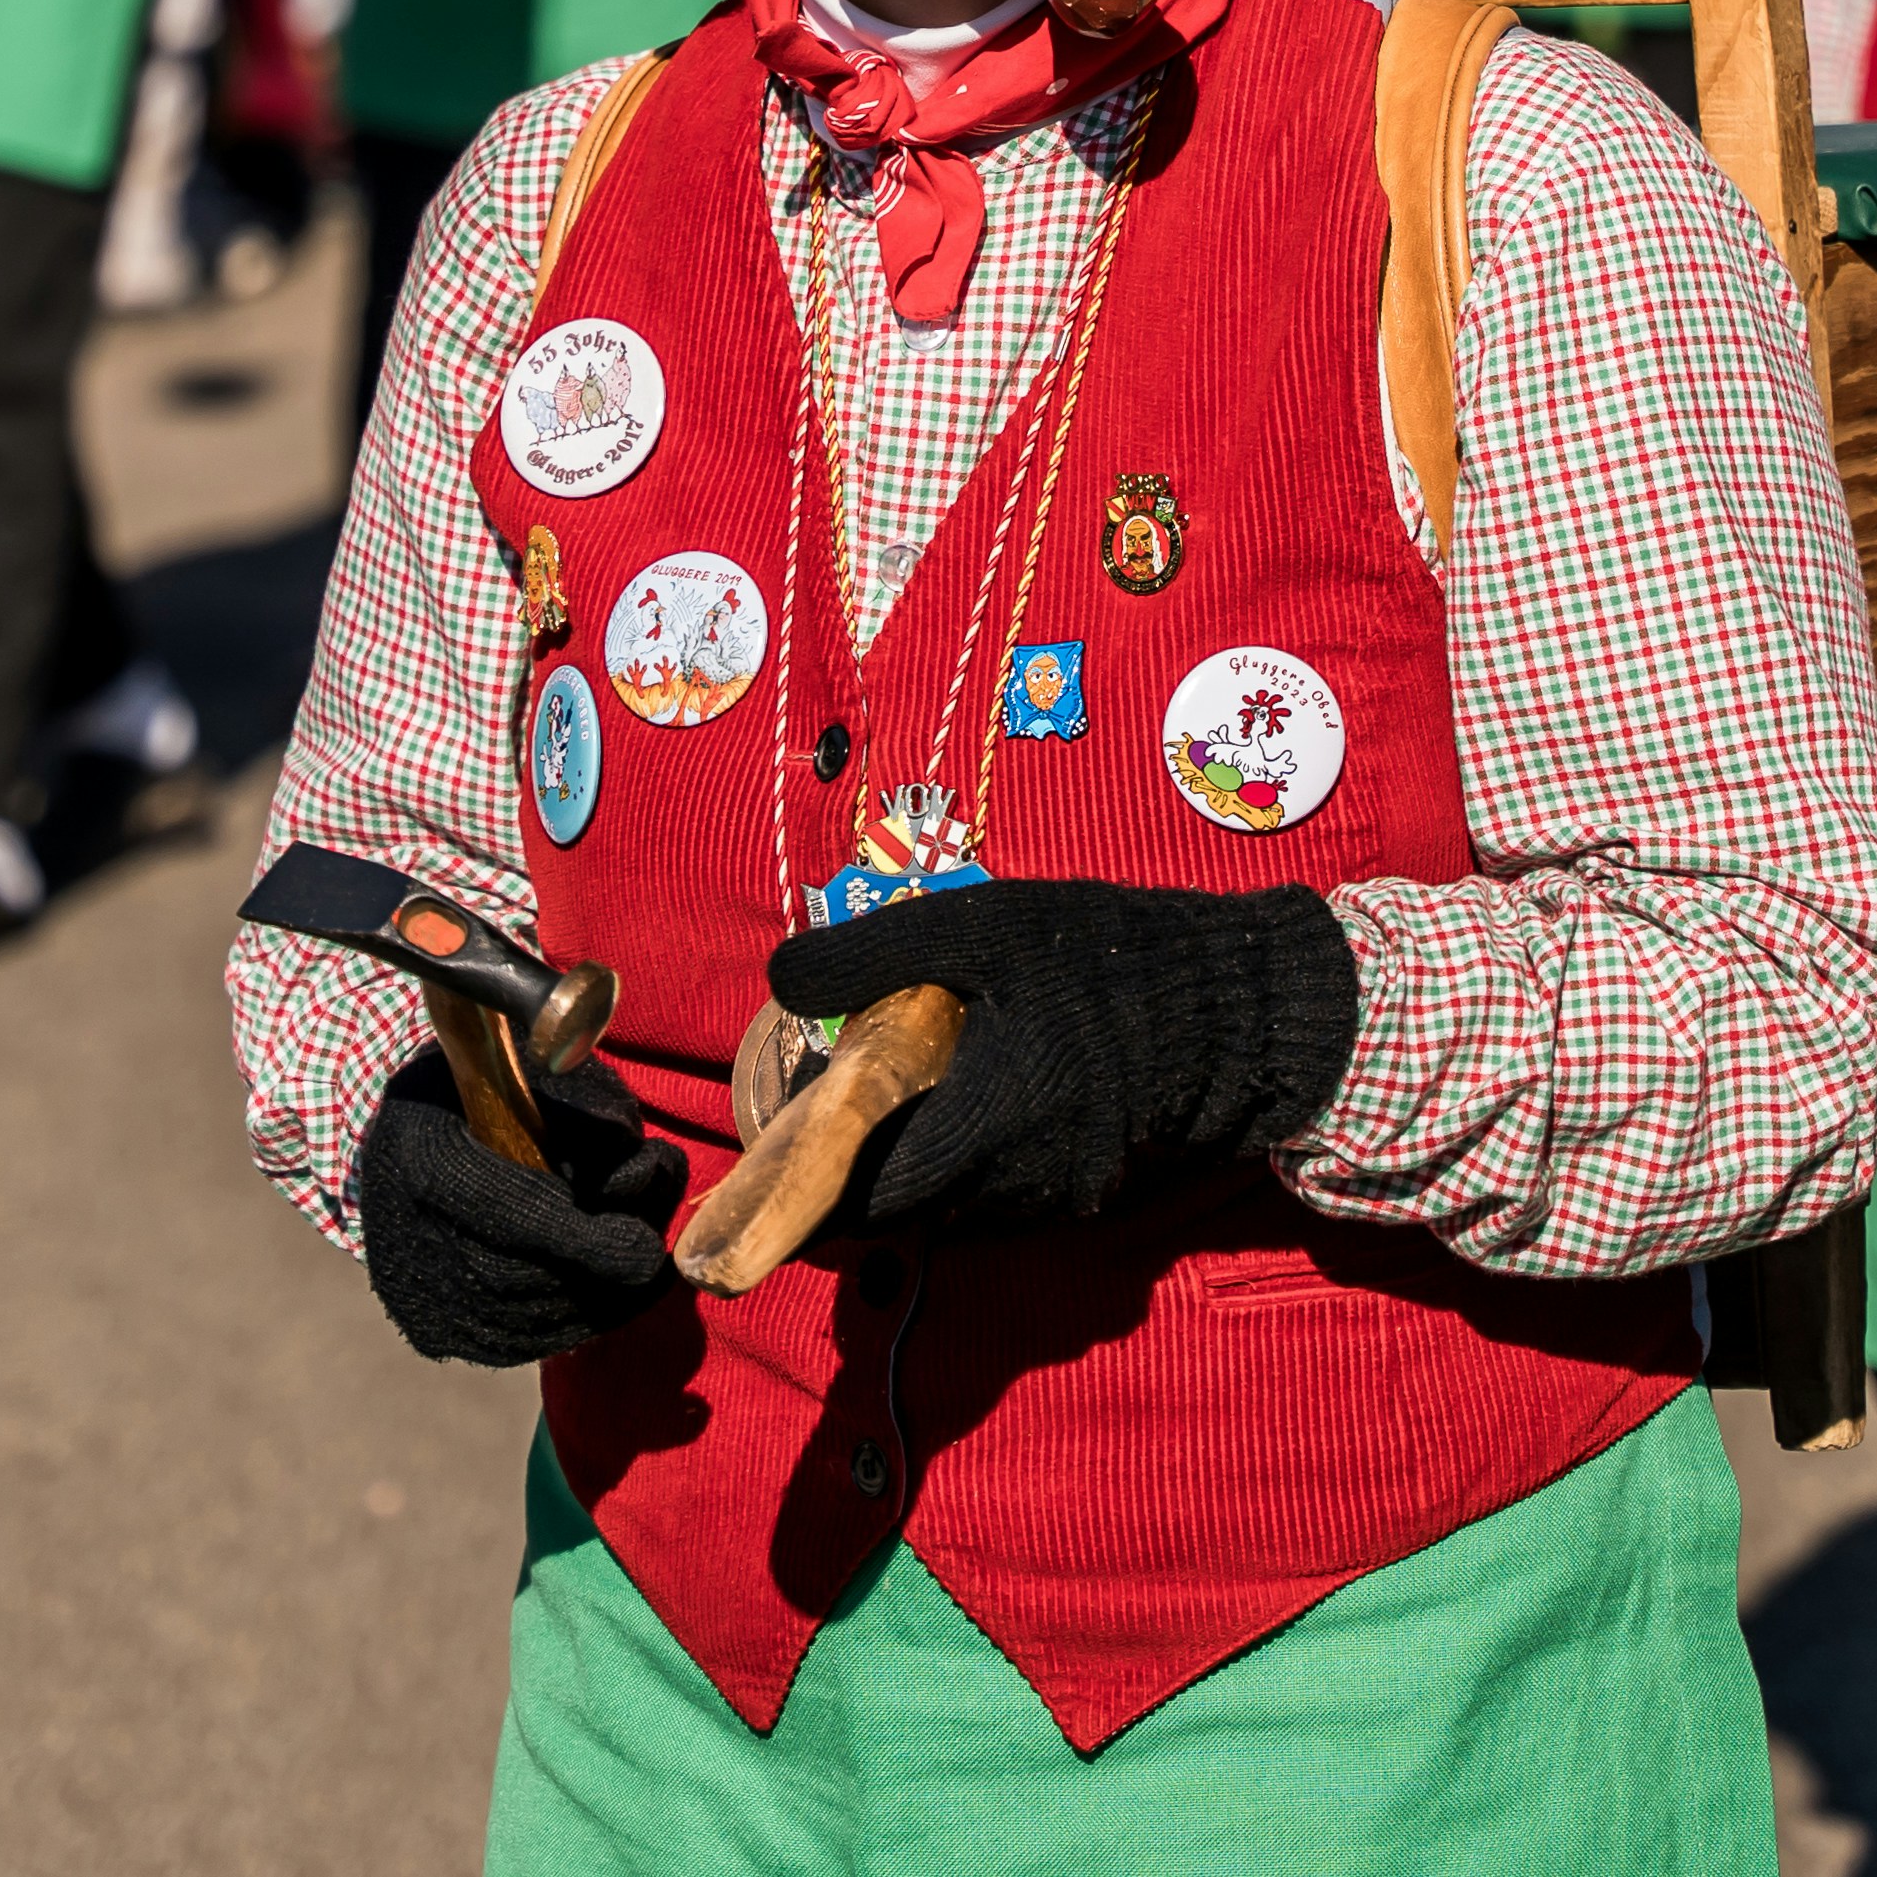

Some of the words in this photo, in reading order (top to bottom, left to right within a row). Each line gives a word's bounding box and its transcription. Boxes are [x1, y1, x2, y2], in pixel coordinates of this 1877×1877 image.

[528, 342, 558, 375] 55
[526, 449, 607, 486] Gluggere
[604, 418, 645, 464] 2017
[714, 573, 743, 587] 2019
[1229, 654, 1305, 686] Gluggere
[1311, 690, 1339, 729] Obed
[1270, 677, 1308, 706] 2023
[879, 784, 956, 822] VON
